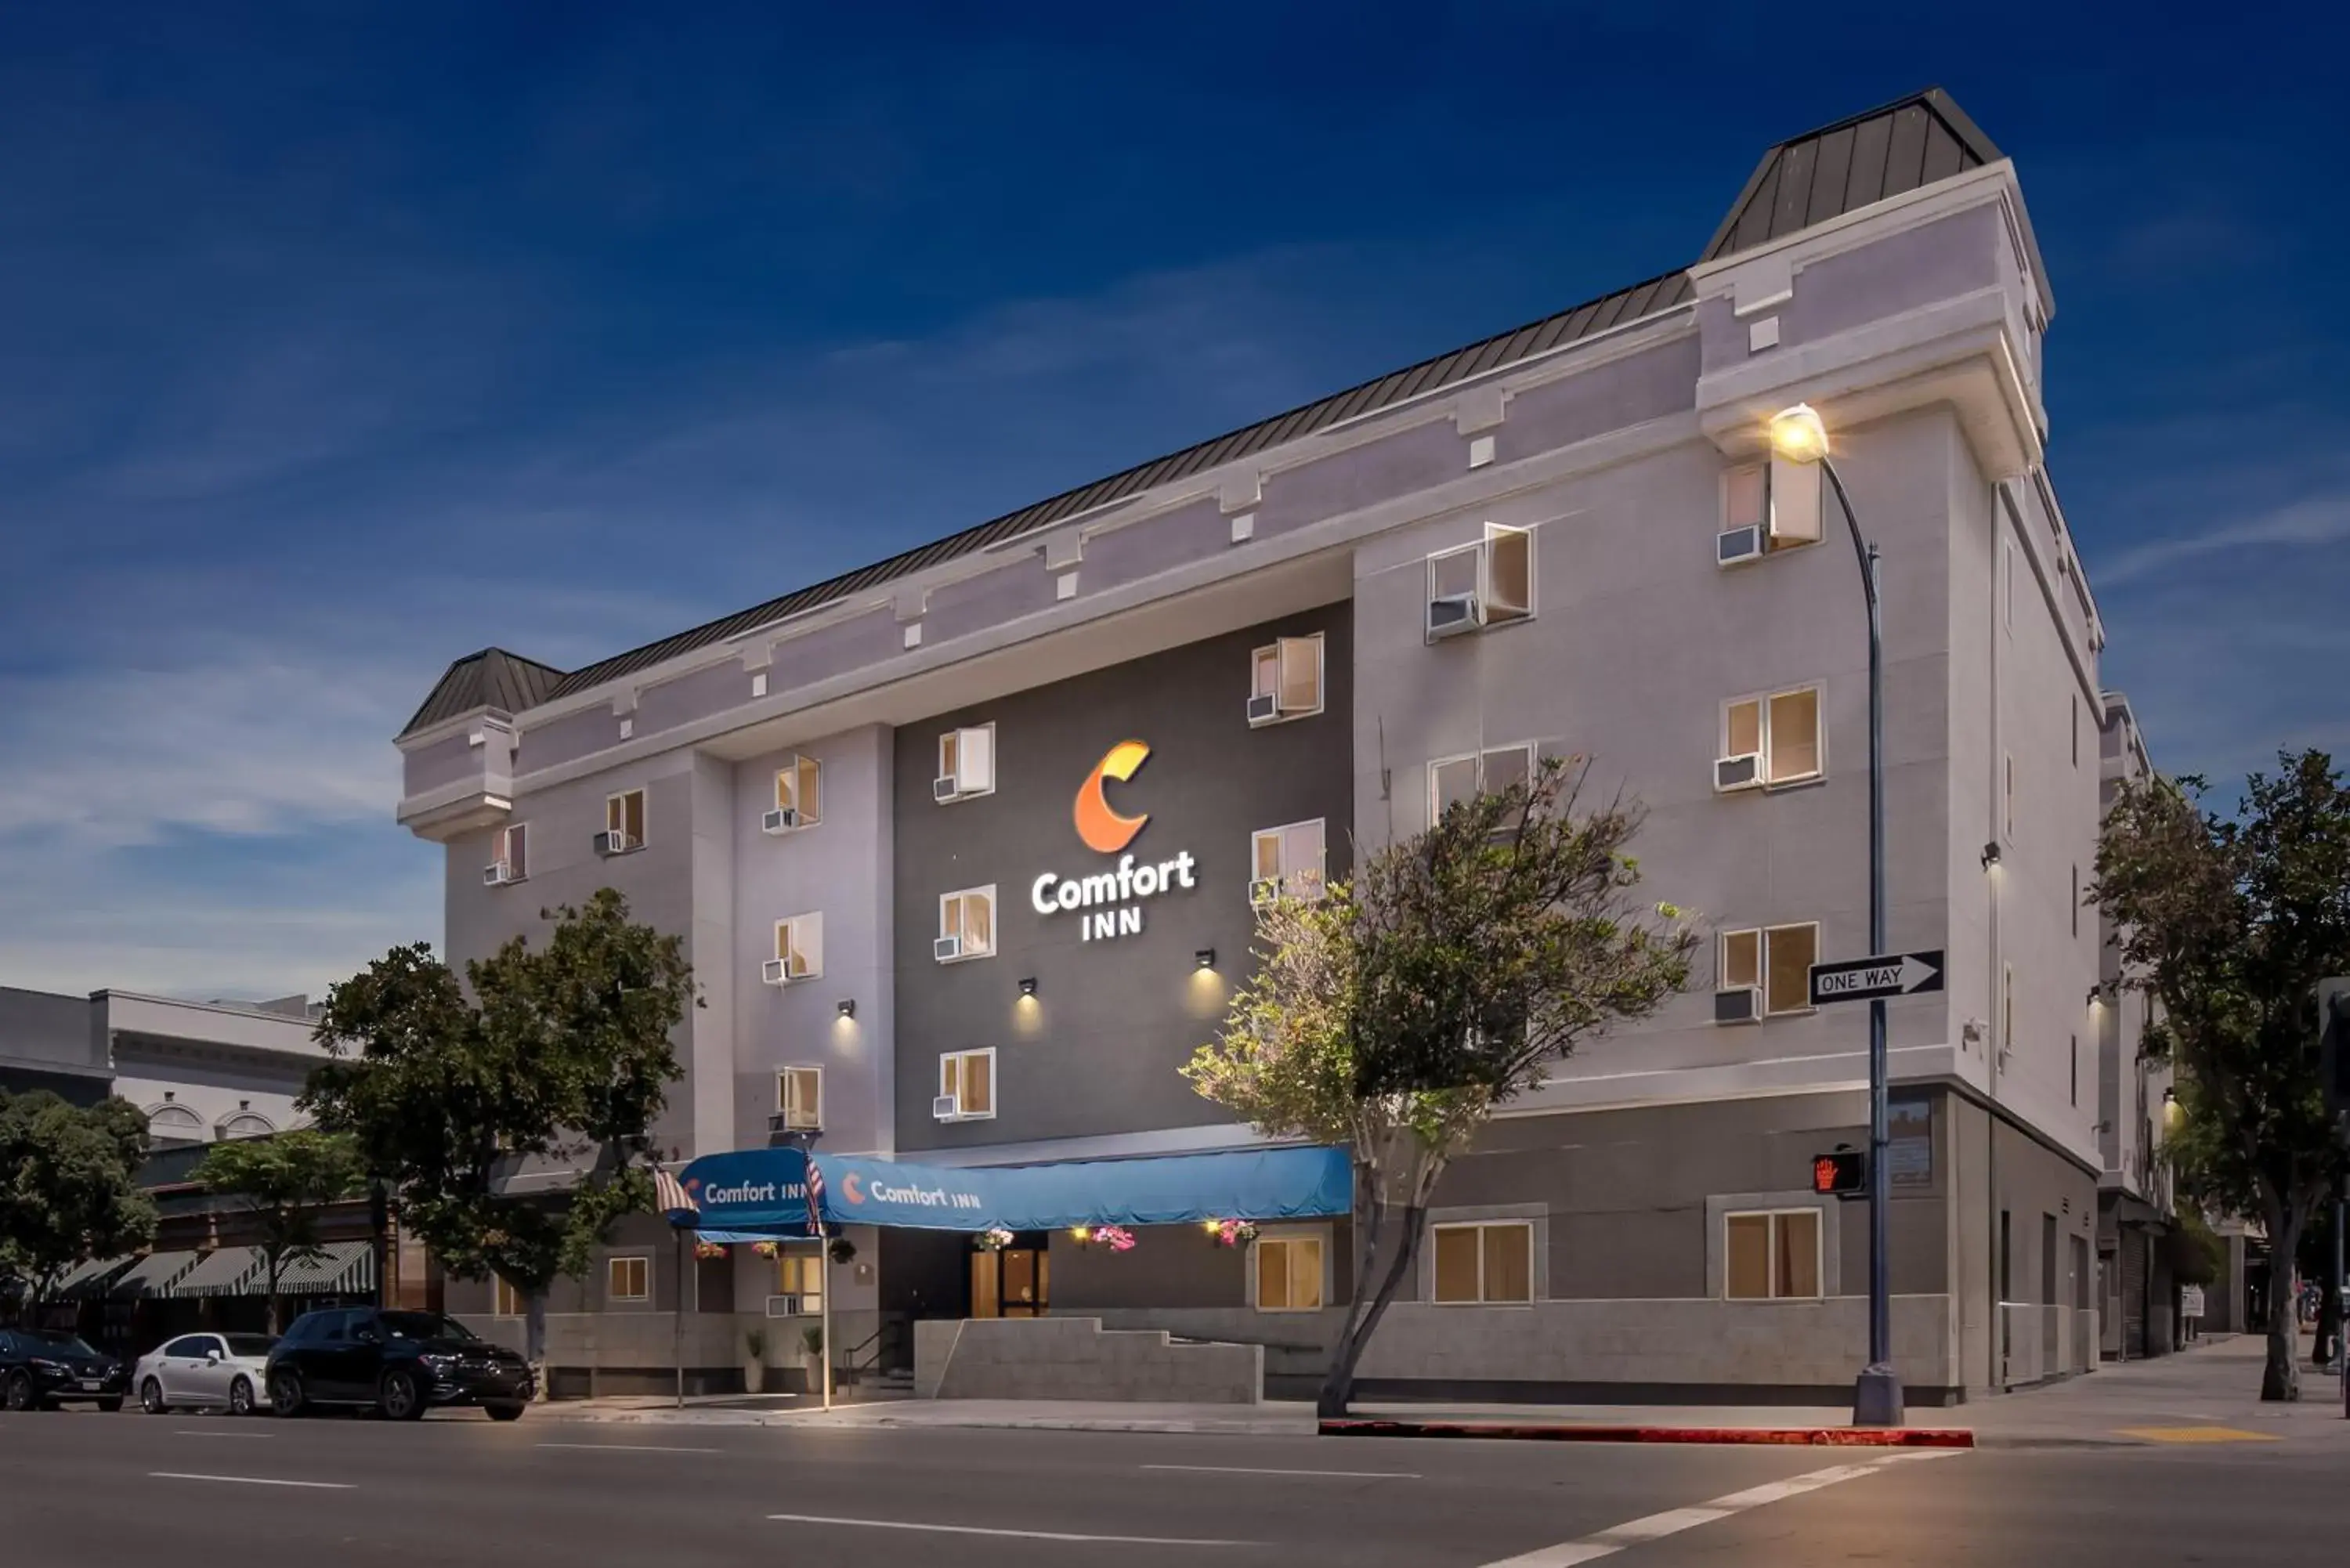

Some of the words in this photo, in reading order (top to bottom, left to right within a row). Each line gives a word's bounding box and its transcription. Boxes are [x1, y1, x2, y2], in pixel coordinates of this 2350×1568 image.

[1032, 851, 1195, 914] Comfort
[1082, 906, 1141, 941] INN
[1822, 973, 1857, 992] ONE
[1865, 967, 1903, 986] WAY
[705, 1180, 776, 1203] Comfort
[871, 1180, 948, 1205] Comfort
[950, 1193, 982, 1209] INN
